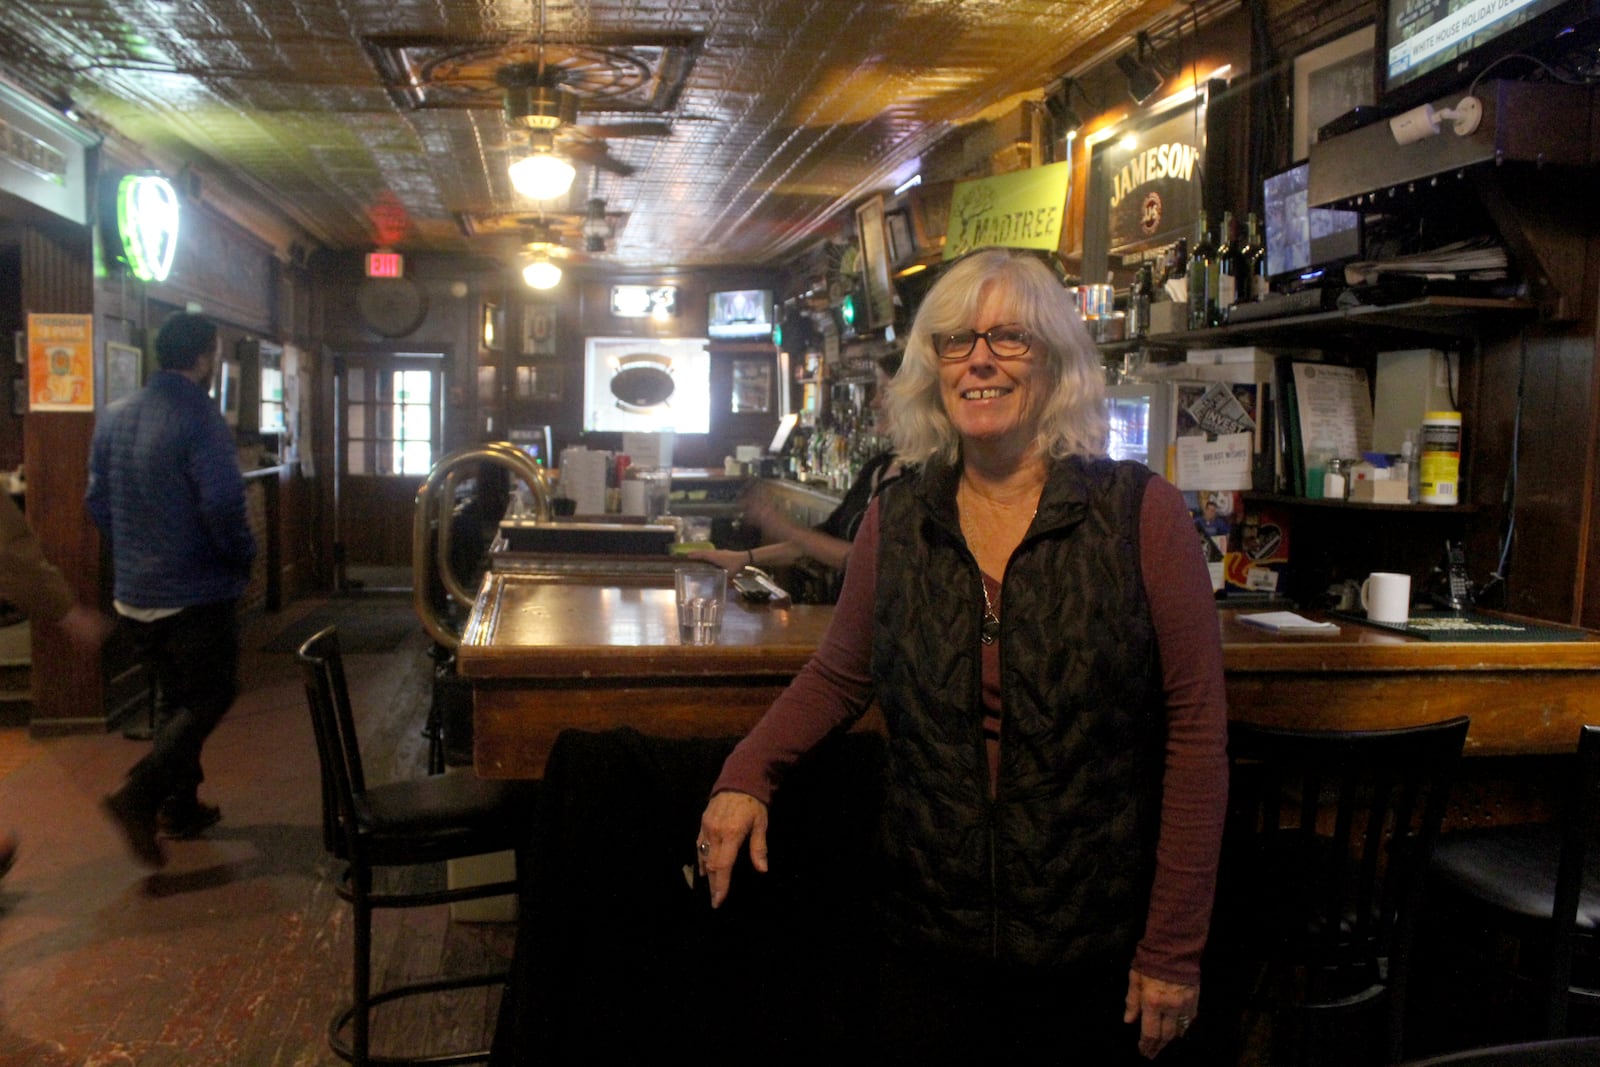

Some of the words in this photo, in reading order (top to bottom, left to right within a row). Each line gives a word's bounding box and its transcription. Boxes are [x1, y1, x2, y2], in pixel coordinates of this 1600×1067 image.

[1412, 36, 1435, 56] WHITE
[1435, 23, 1460, 45] HOUSE
[1462, 3, 1495, 32] HOLIDAY
[1111, 143, 1197, 207] JAMESON
[973, 206, 1057, 246] MADTREE
[371, 253, 399, 277] EXIT
[1205, 408, 1244, 433] INVEST
